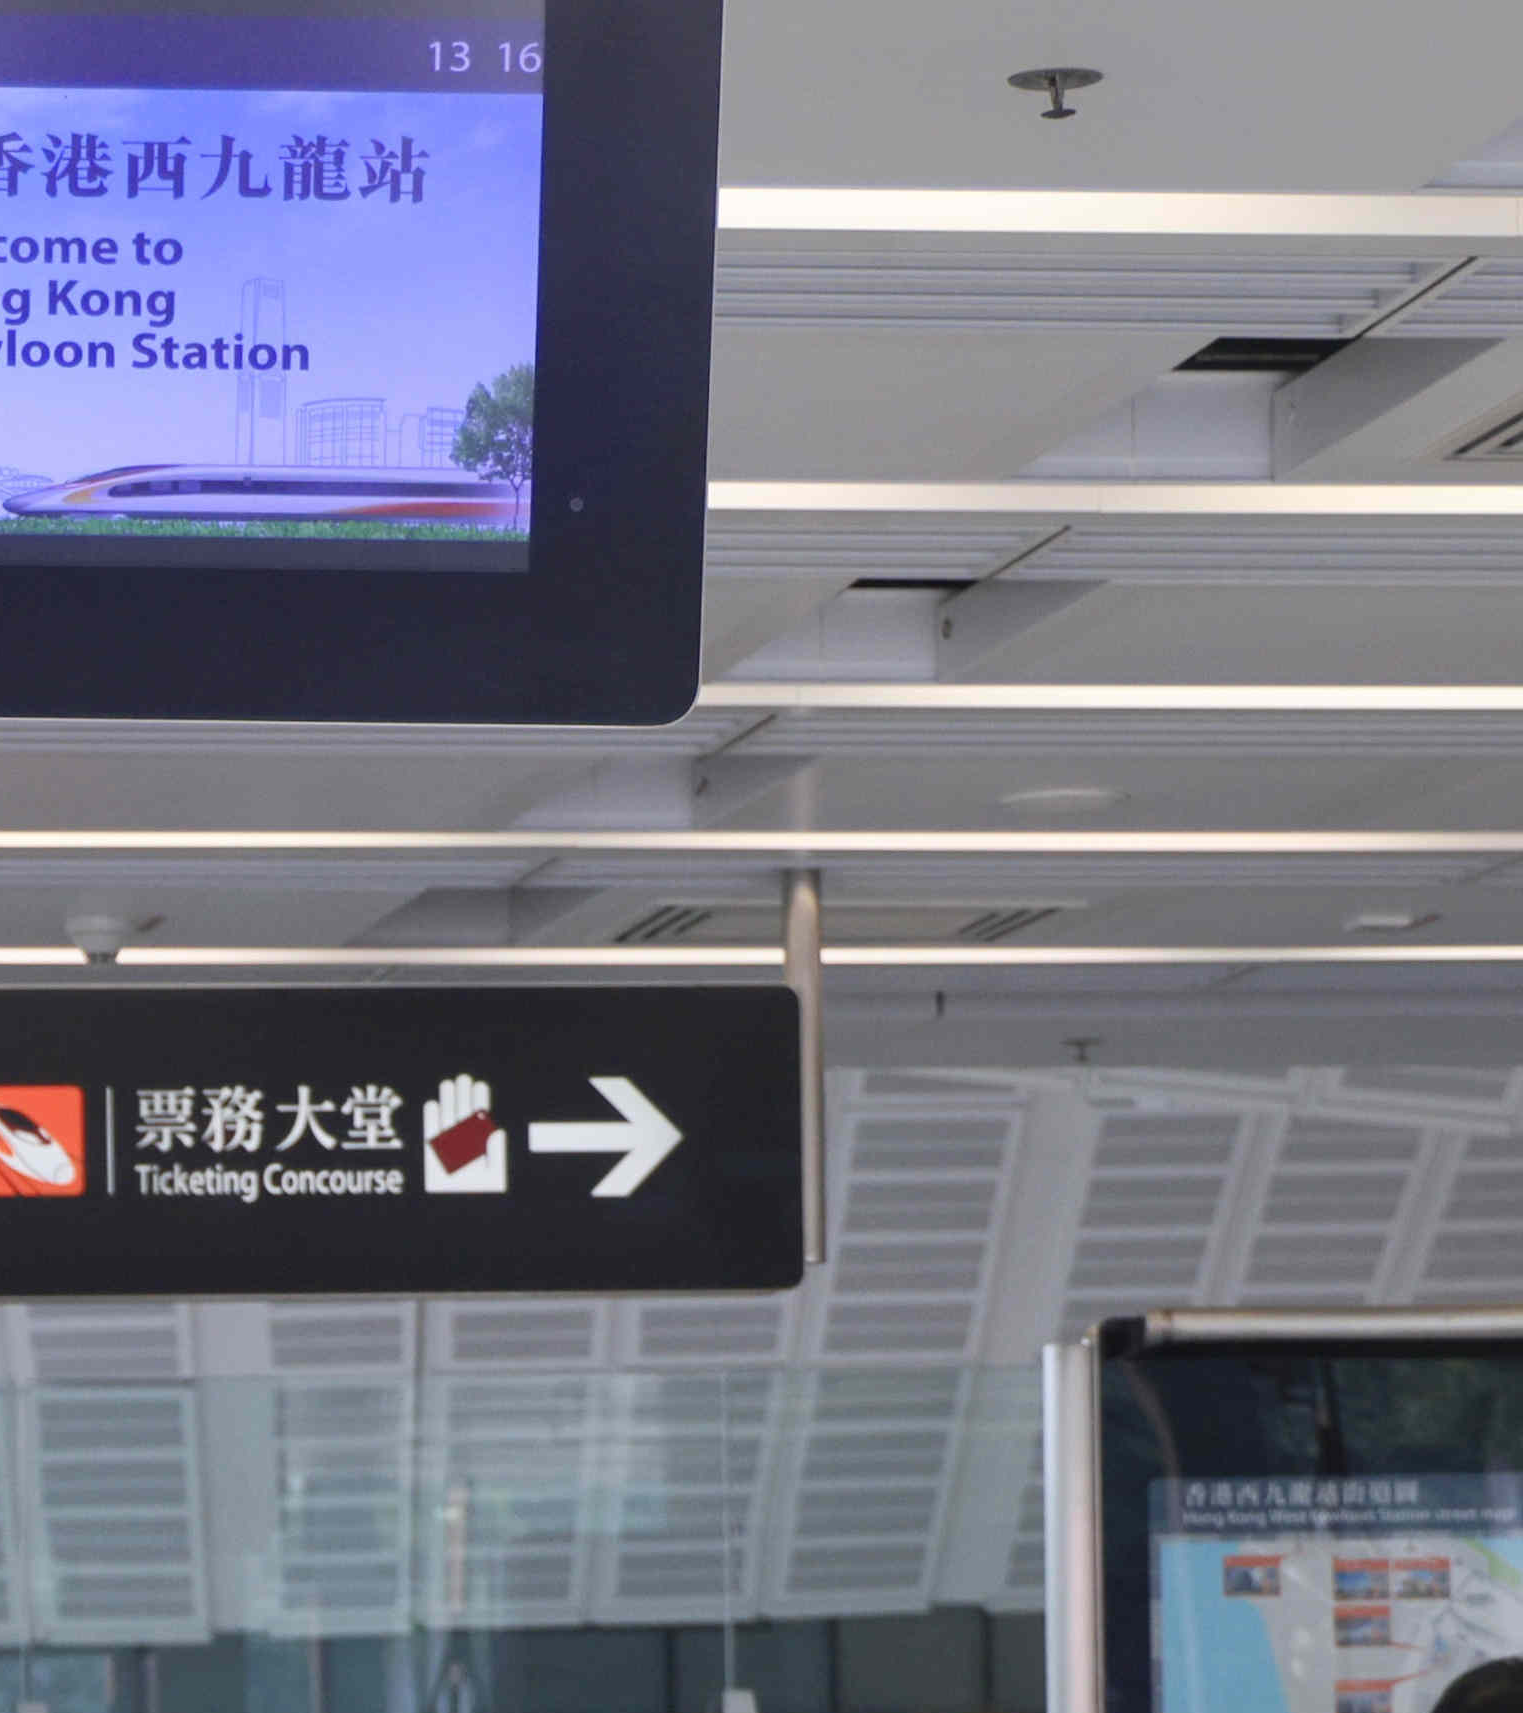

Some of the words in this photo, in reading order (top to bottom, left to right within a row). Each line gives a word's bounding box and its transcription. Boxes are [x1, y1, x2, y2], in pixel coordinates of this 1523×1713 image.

[428, 40, 472, 73] 13
[497, 42, 542, 74] 16
[132, 232, 184, 266] to
[48, 279, 176, 328] Kong
[132, 332, 310, 371] Station
[134, 1084, 405, 1153] 票務大堂
[134, 1162, 257, 1204] Ticketing
[262, 1162, 404, 1196] Concourse
